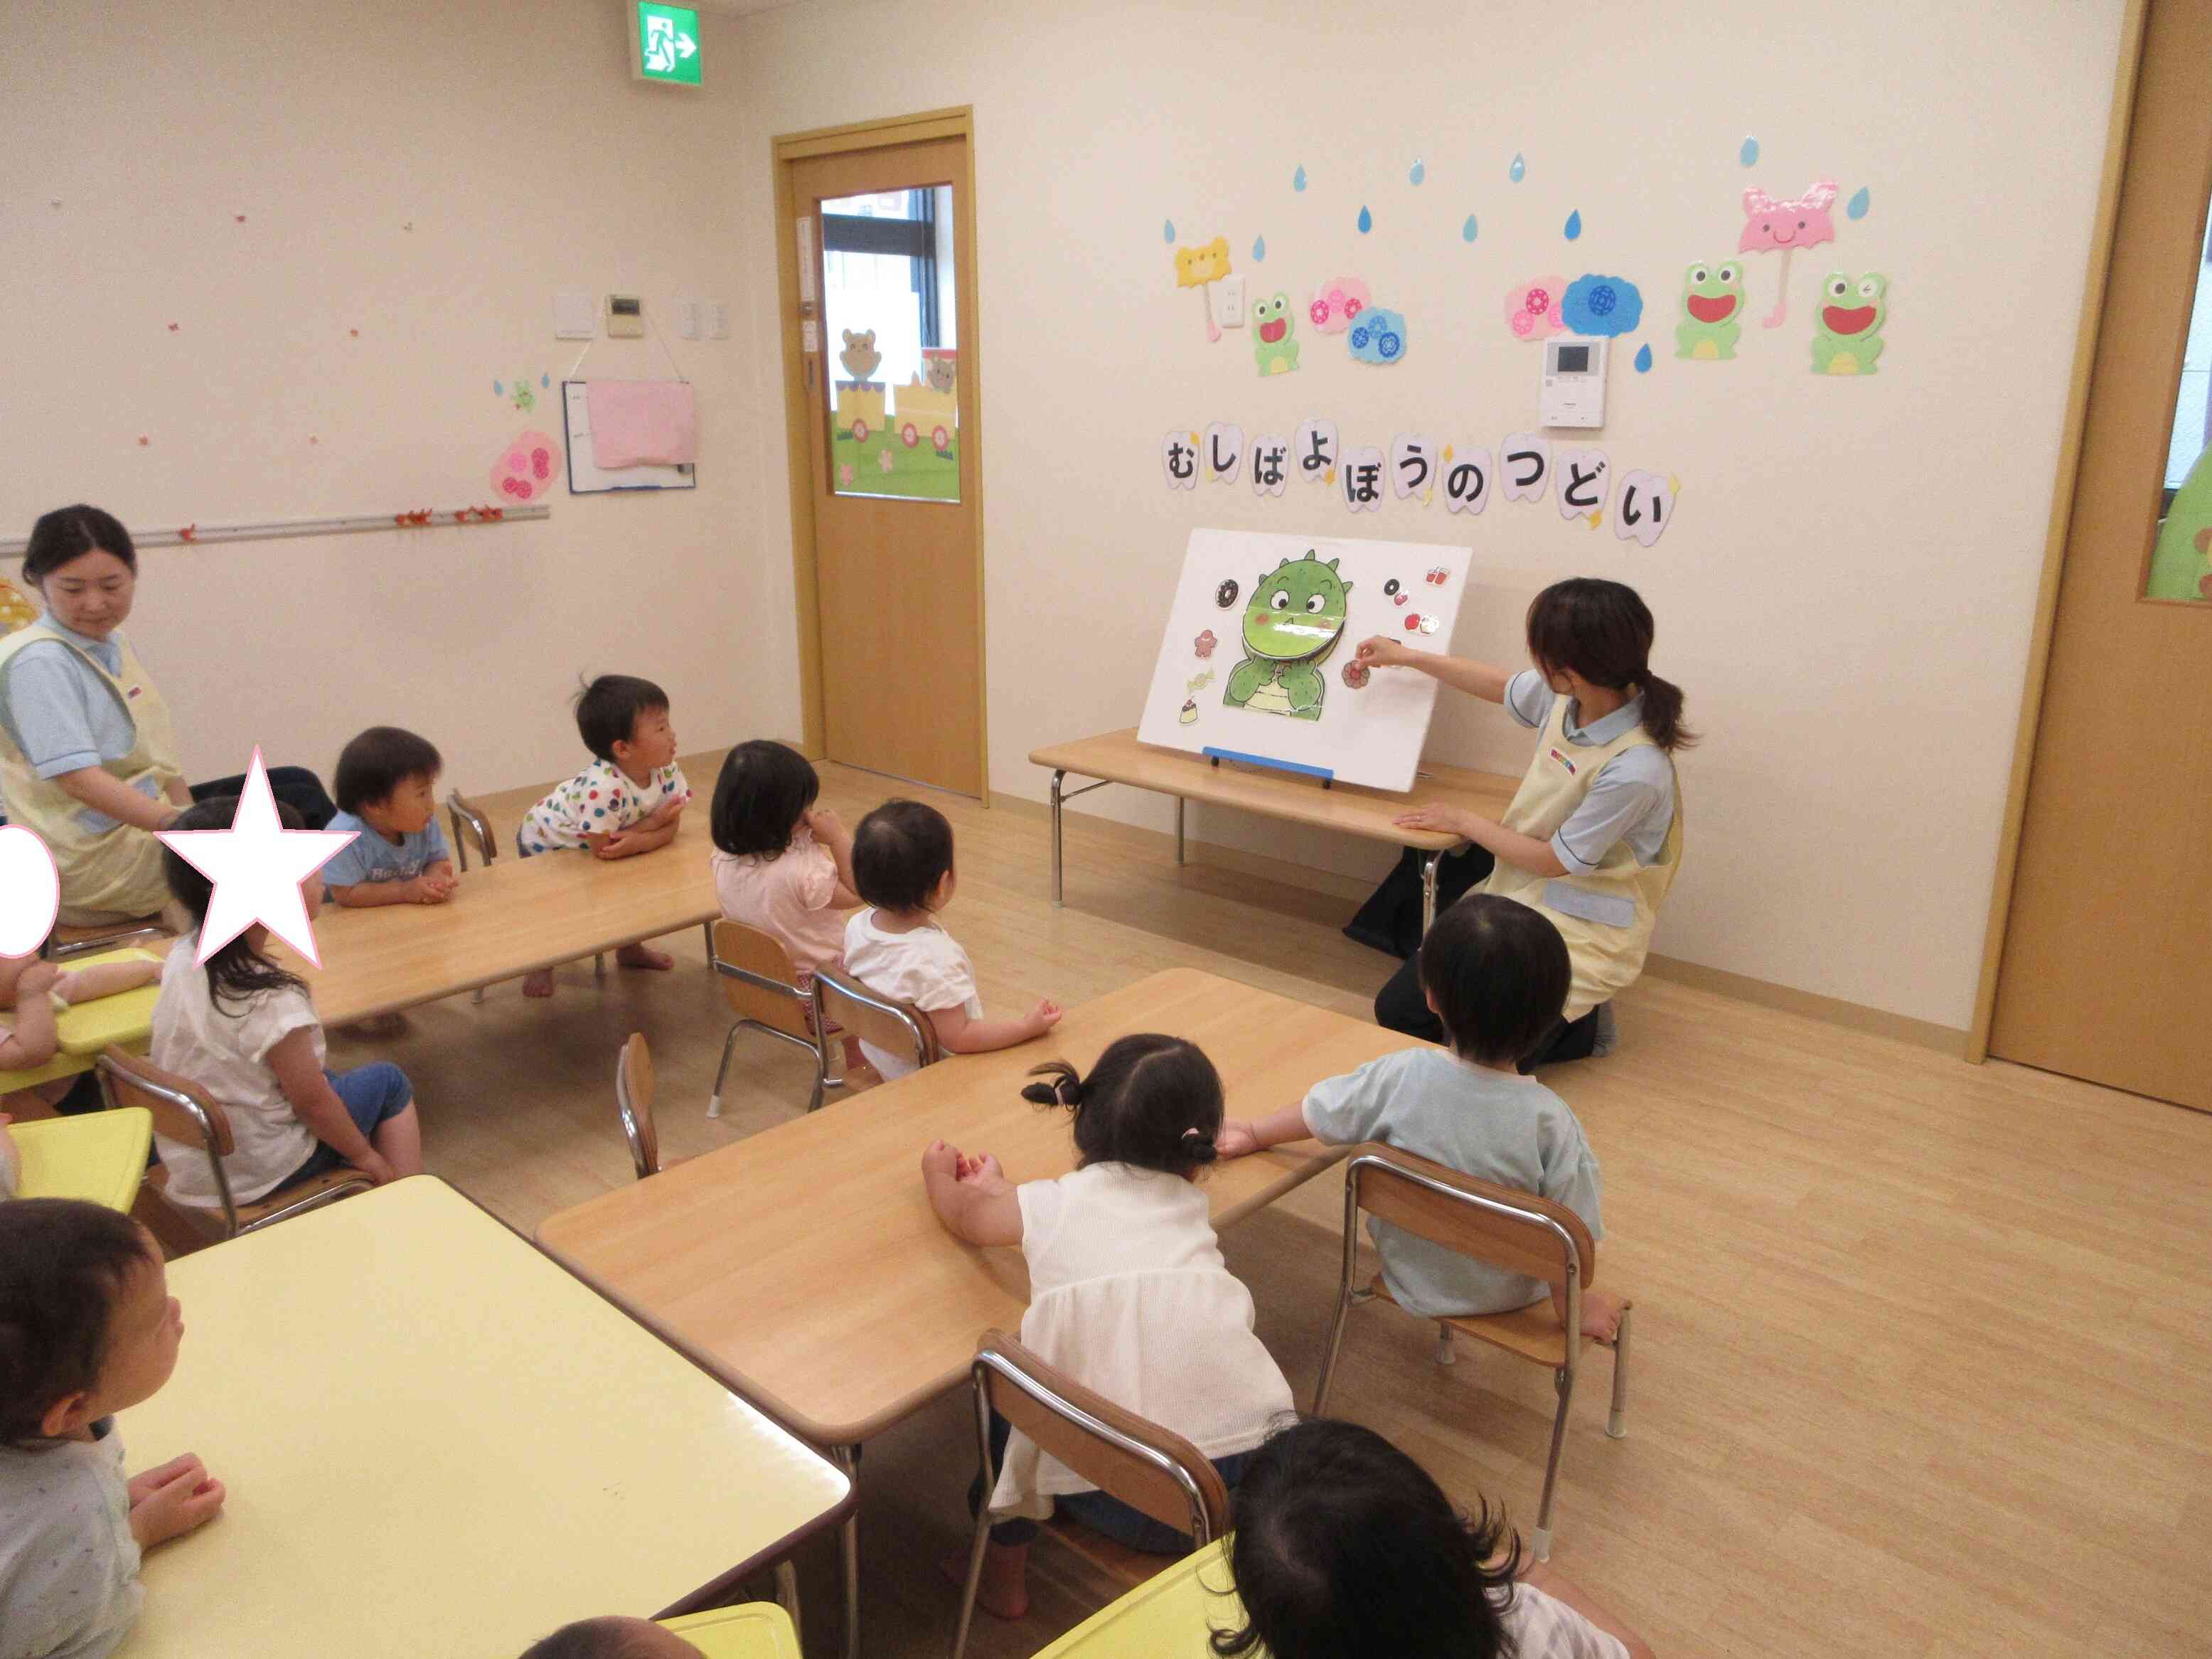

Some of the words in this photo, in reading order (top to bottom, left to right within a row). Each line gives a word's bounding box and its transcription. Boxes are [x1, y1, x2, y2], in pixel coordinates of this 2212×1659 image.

[1168, 430, 1662, 526] むしばよぼうのつどい
